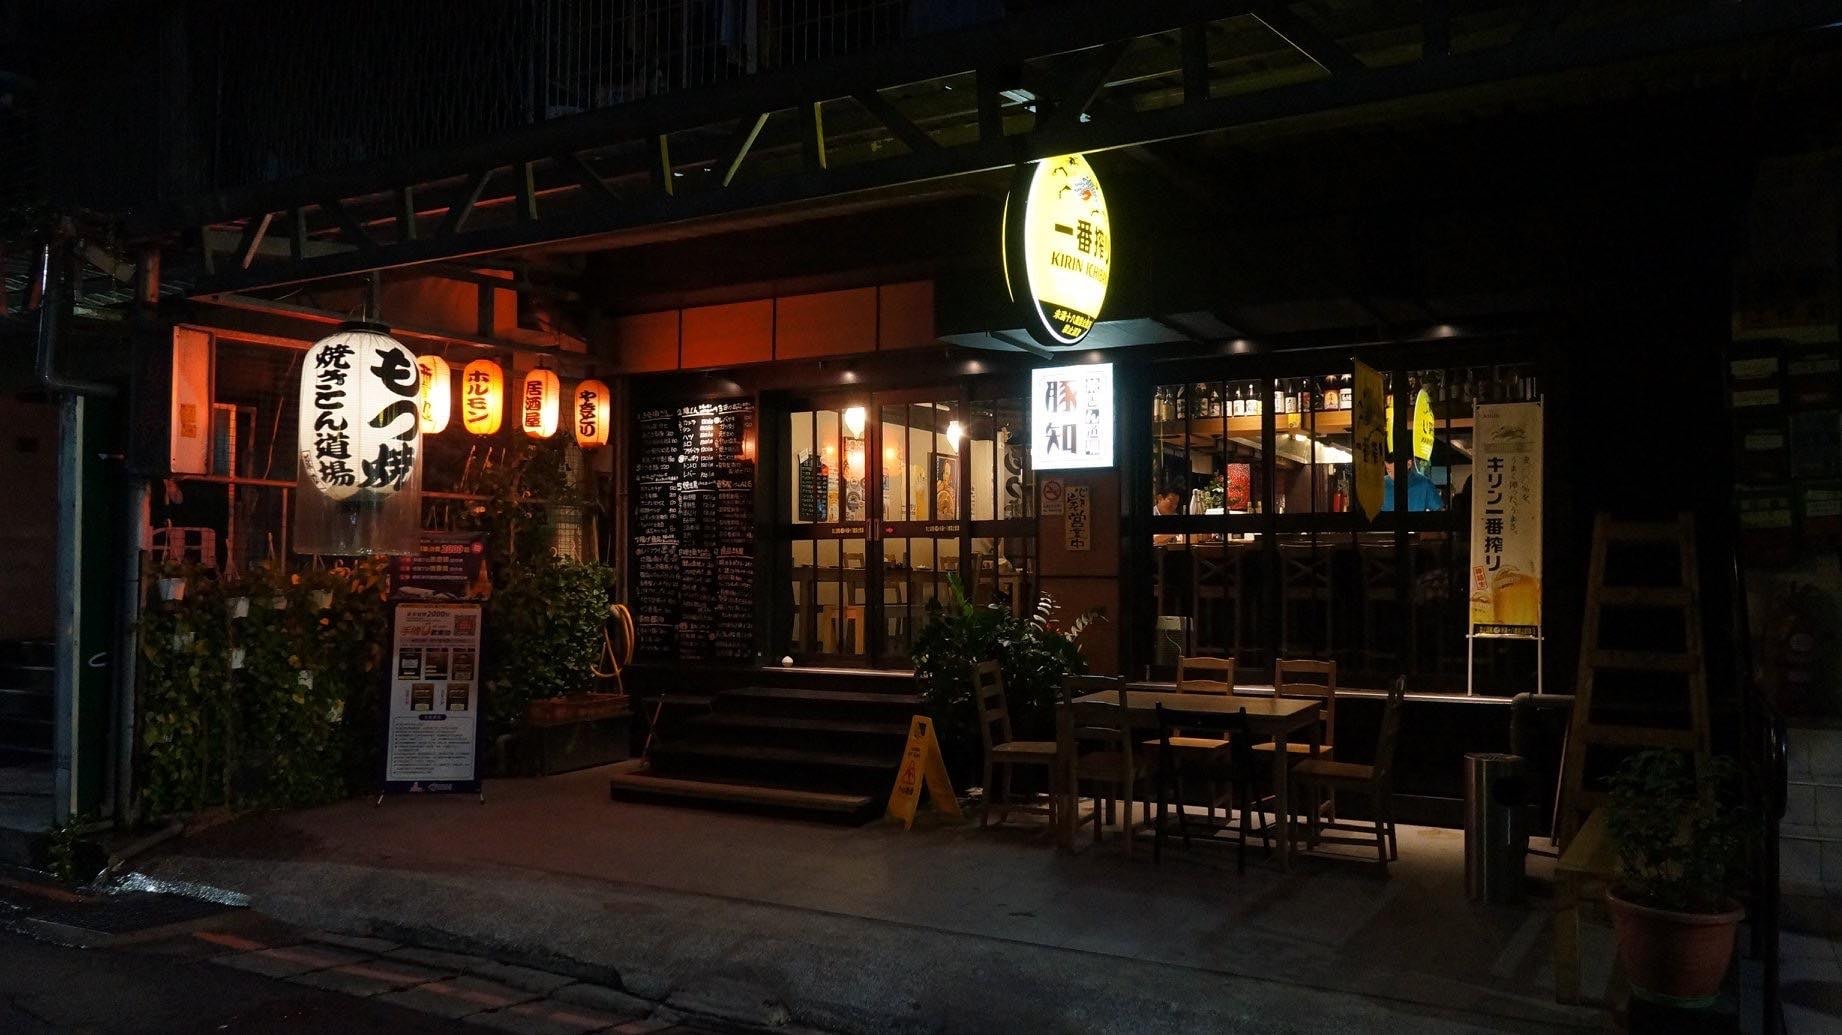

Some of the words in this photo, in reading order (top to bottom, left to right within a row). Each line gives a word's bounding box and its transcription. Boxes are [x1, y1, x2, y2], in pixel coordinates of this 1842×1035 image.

[1051, 251, 1083, 272] KIRIN
[467, 370, 490, 423] ホルモン
[524, 380, 542, 427] 居酒屋
[579, 390, 596, 437] やきとり
[1485, 457, 1504, 571] キリン一番搾り
